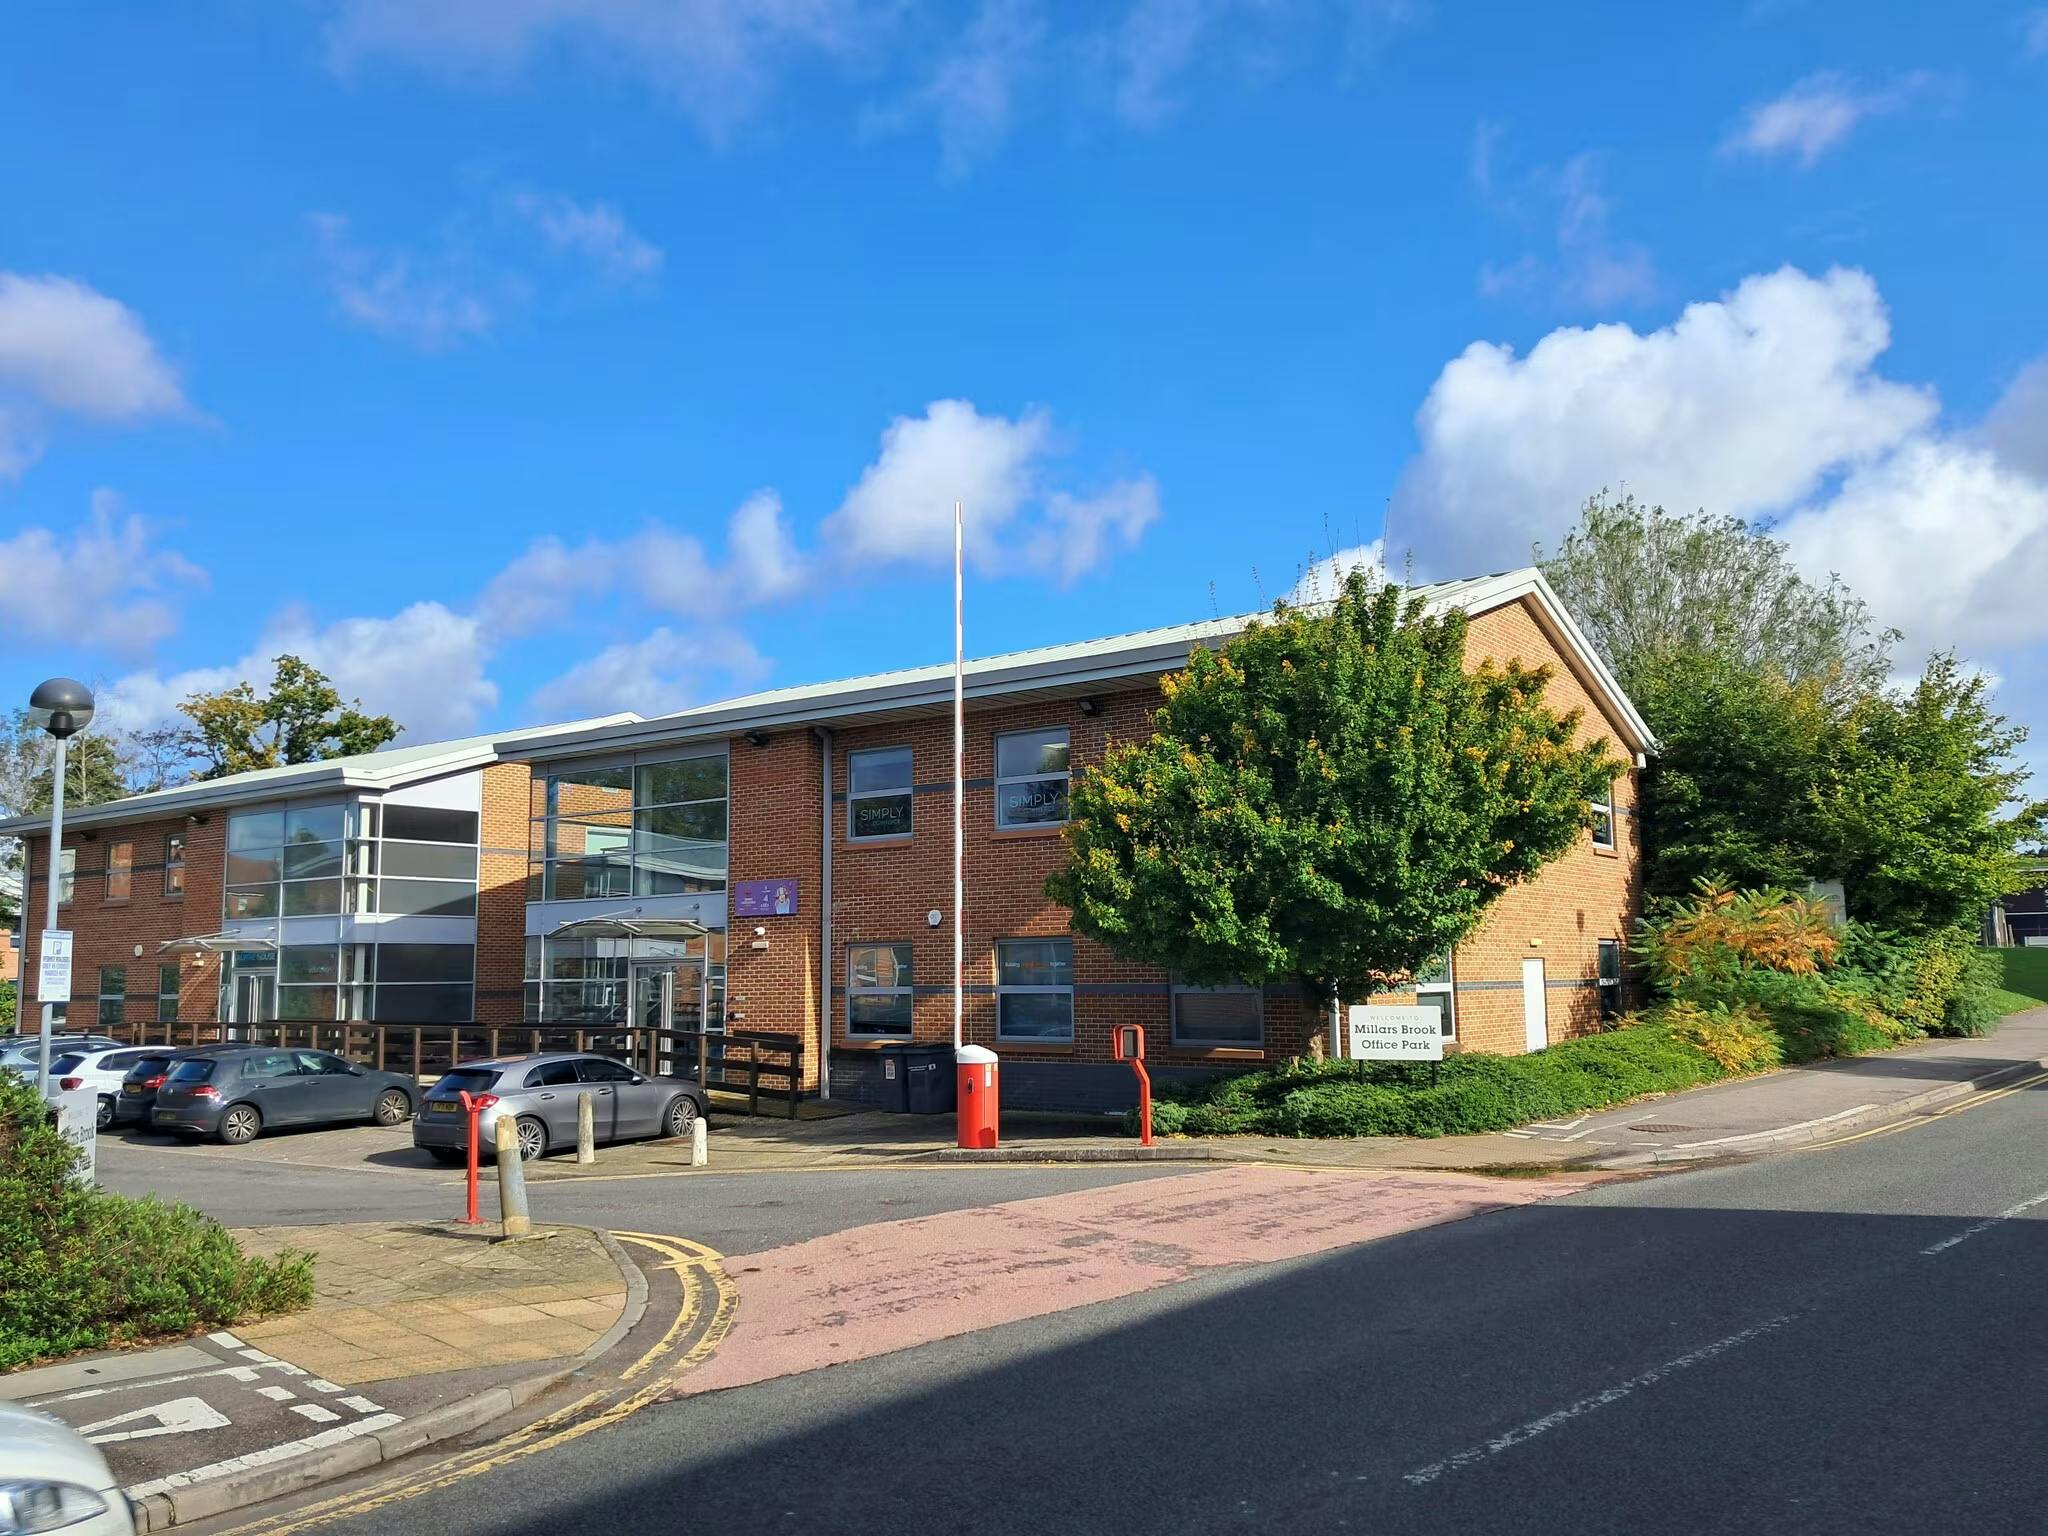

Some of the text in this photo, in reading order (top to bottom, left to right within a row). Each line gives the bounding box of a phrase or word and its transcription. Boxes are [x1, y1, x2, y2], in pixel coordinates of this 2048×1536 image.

[1354, 1024, 1436, 1035] Millars Brook
[1361, 1039, 1431, 1050] Office Park
